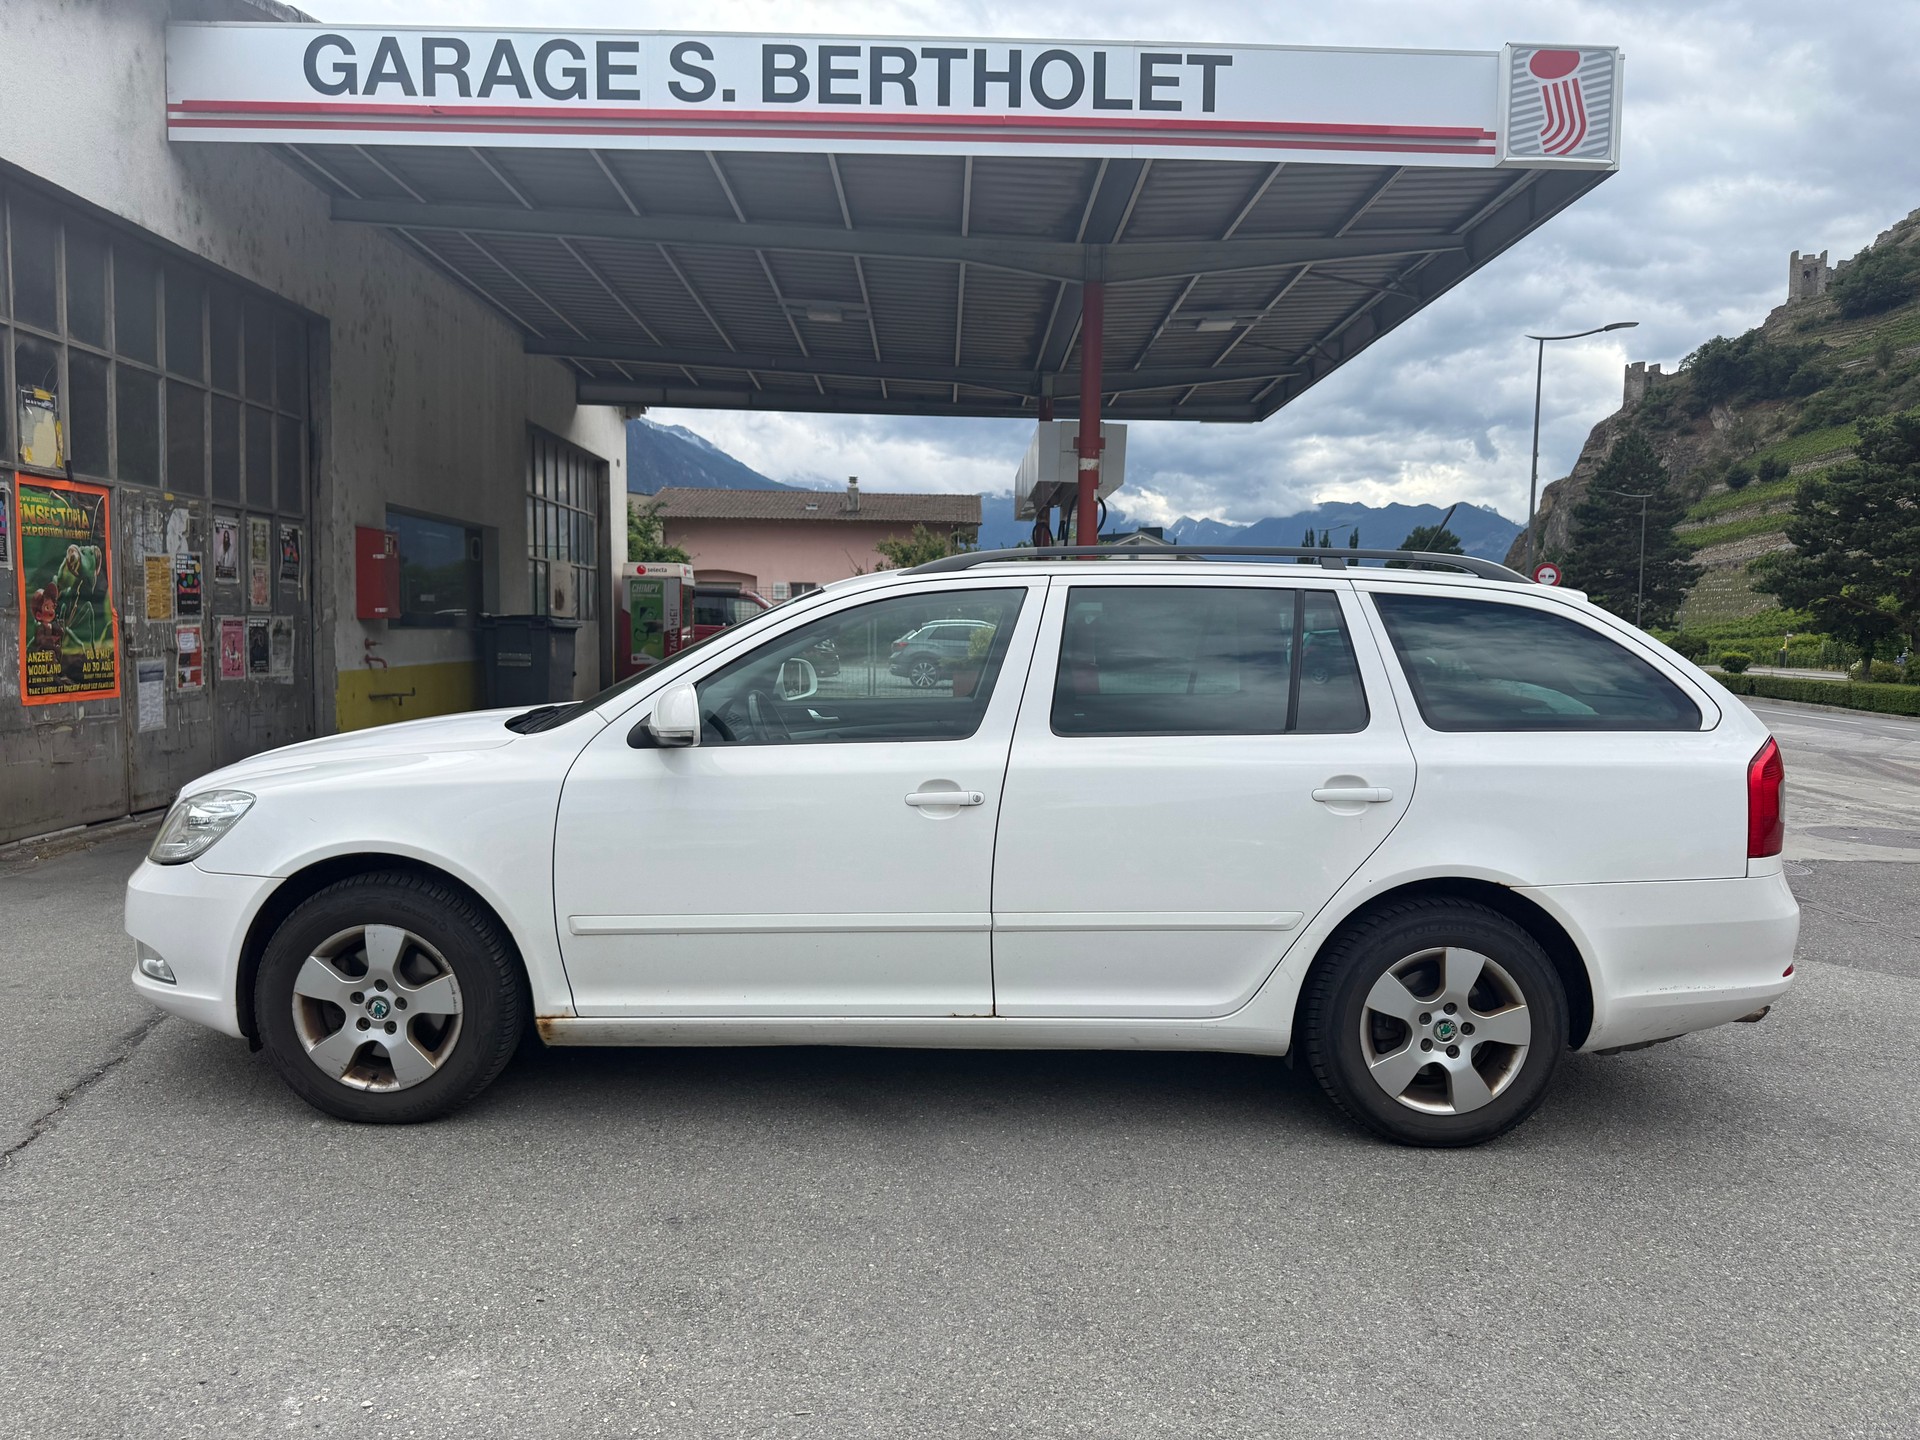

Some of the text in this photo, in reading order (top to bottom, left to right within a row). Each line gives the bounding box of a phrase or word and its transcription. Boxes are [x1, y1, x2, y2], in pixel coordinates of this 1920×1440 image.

[303, 33, 1233, 113] GARAGE S. BERTHOLET
[631, 583, 660, 593] CHIMPY
[669, 628, 678, 653] TAKE
[28, 663, 62, 676] WOODLAND
